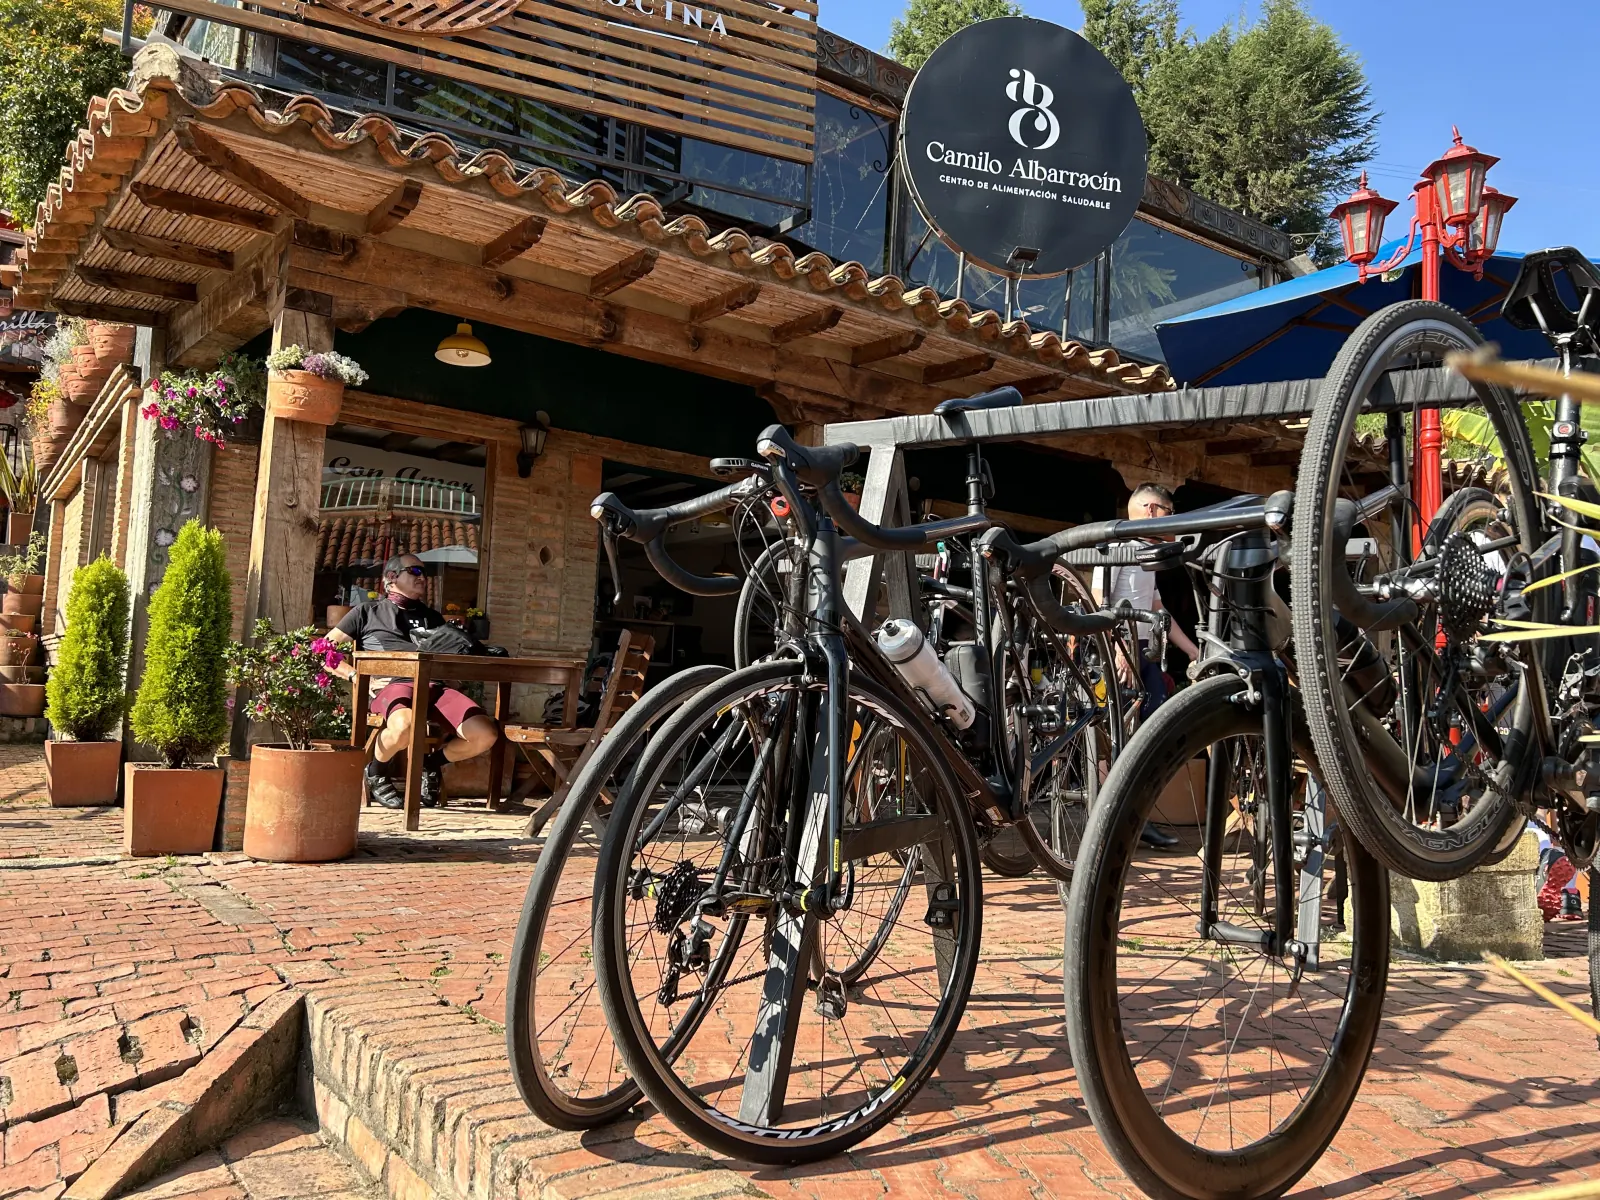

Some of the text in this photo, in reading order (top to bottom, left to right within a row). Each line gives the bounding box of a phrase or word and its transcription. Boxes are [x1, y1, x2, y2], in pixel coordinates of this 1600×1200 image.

[926, 140, 1122, 193] Camilo Albarracín
[939, 174, 1111, 209] CENTRO DE ALIMENTACIÓN SALUDABLE
[328, 456, 475, 494] Con Amor
